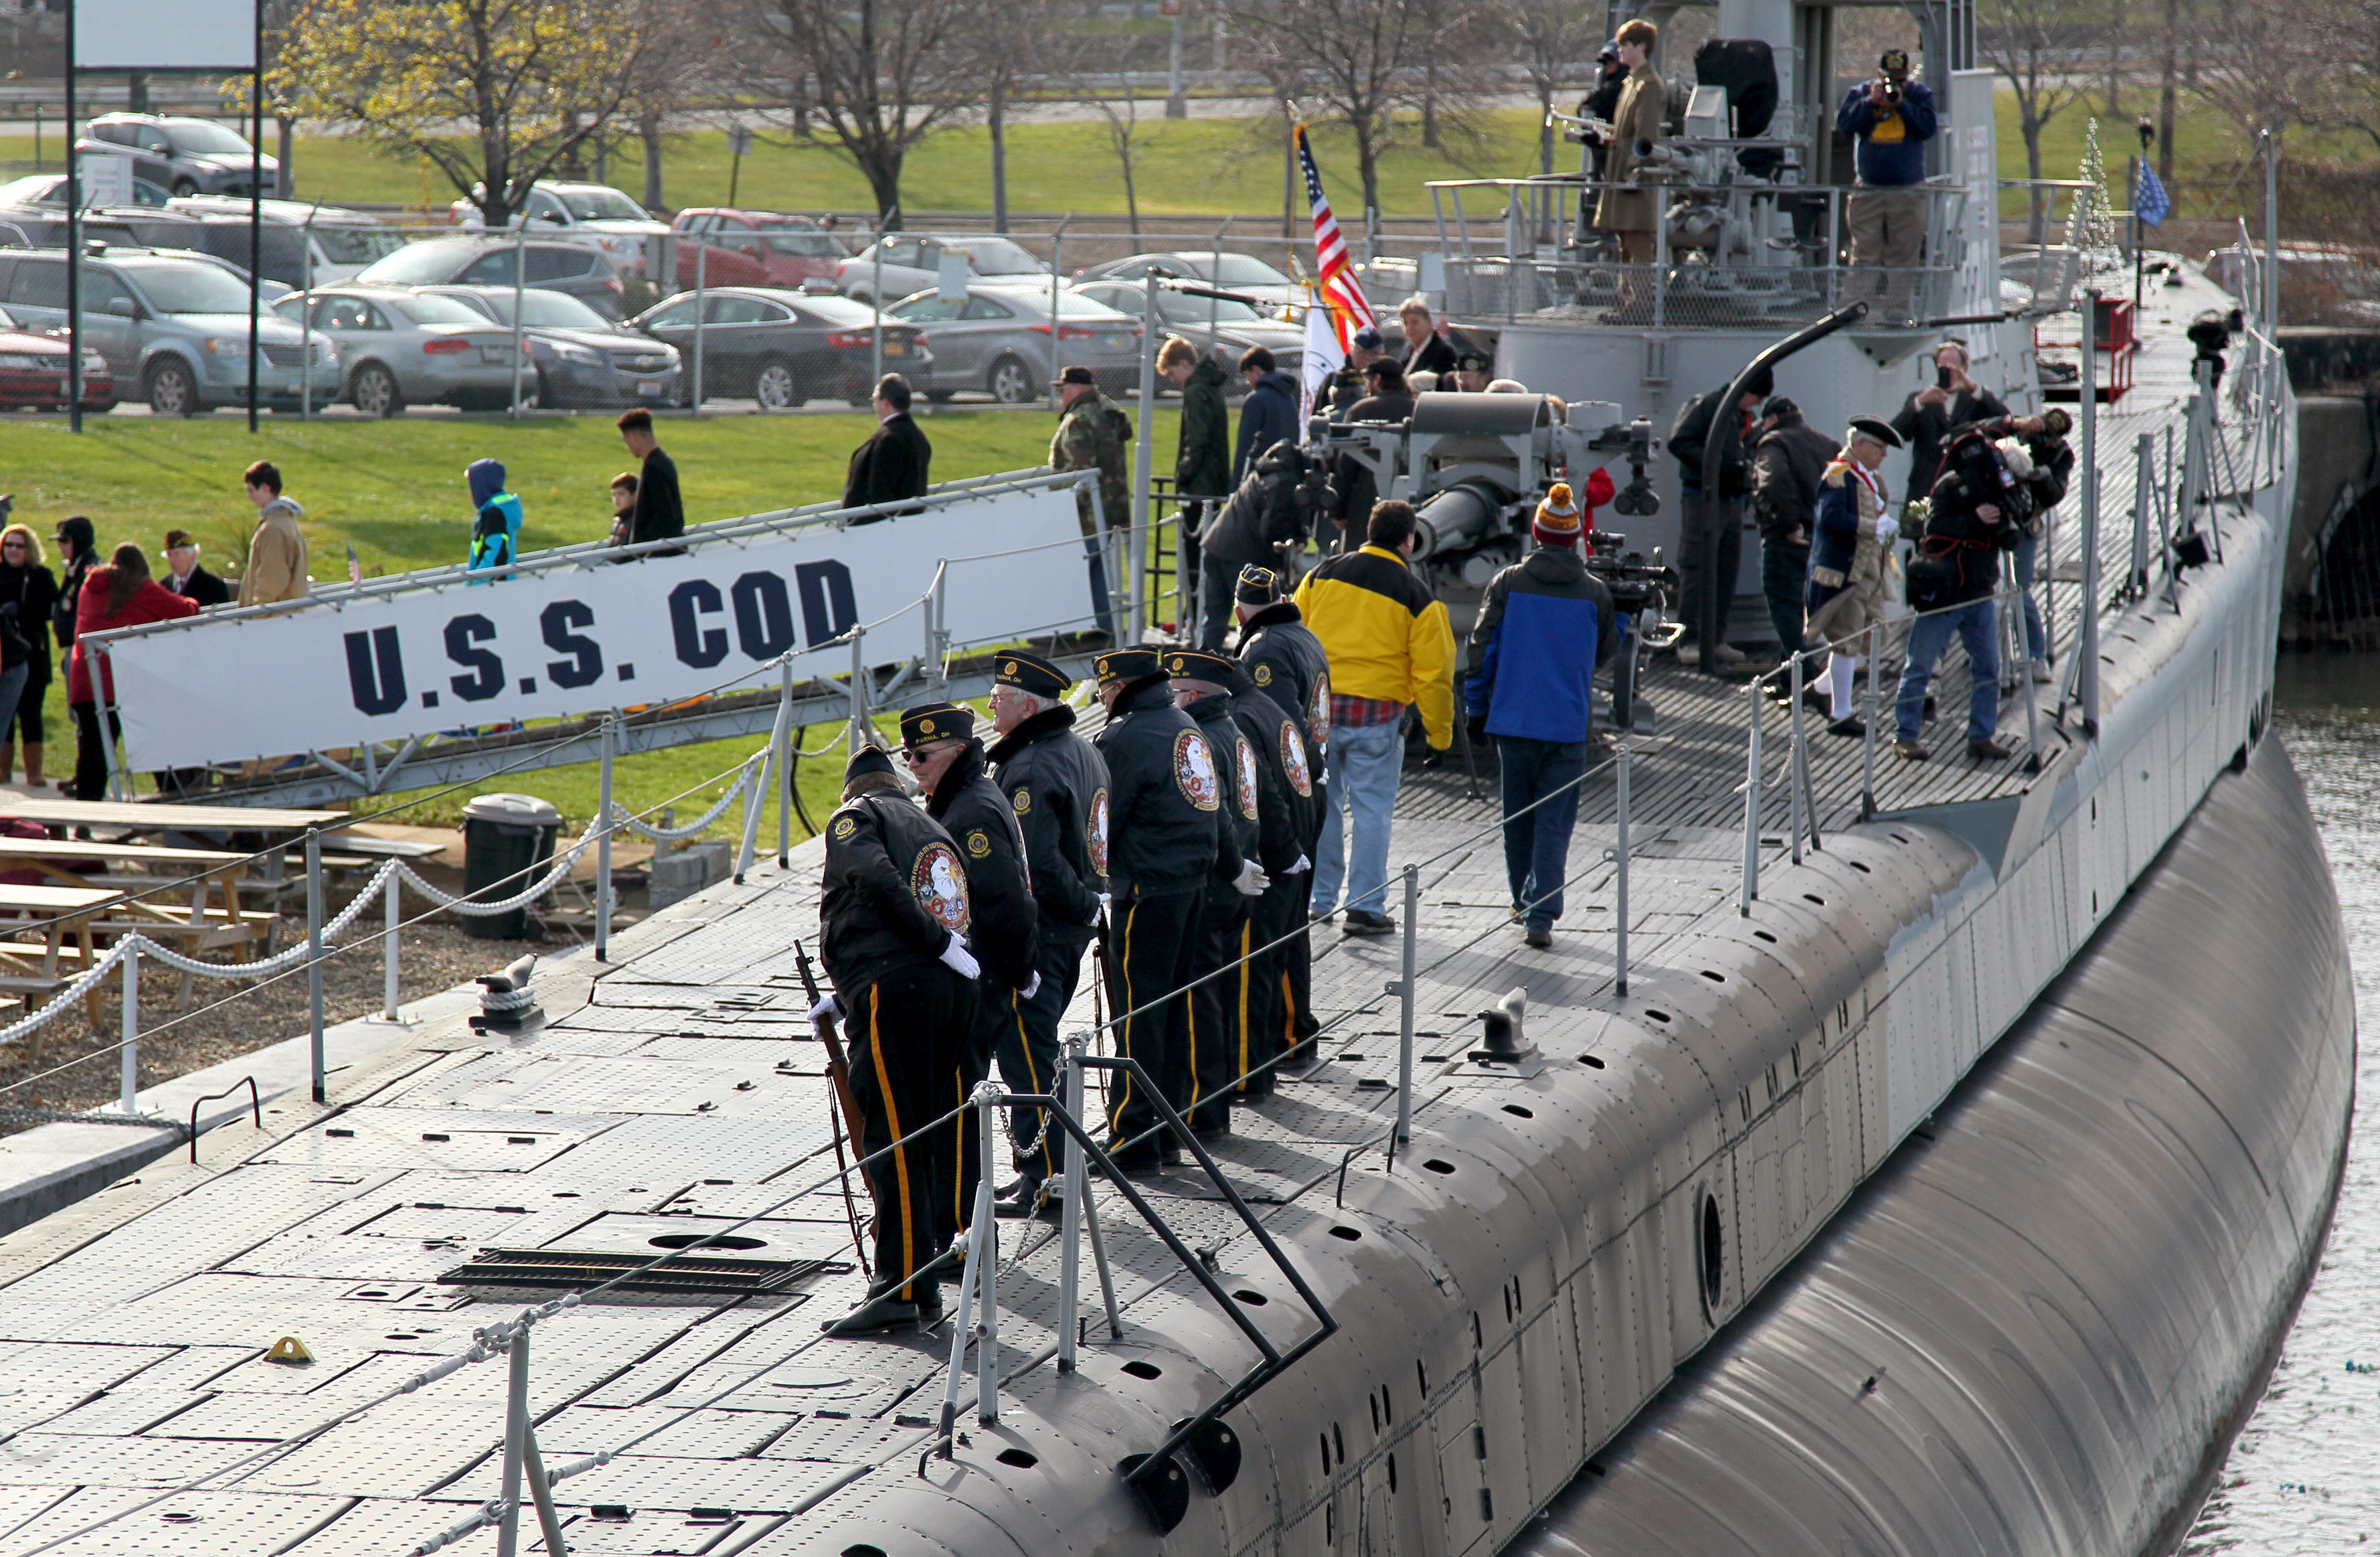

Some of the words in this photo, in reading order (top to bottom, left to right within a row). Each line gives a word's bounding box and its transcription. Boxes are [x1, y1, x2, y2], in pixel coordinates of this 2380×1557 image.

[344, 599, 636, 716] U.S.S.
[668, 558, 859, 669] COD
[916, 734, 938, 744] PARMA,
[912, 851, 924, 875] FORGETS
